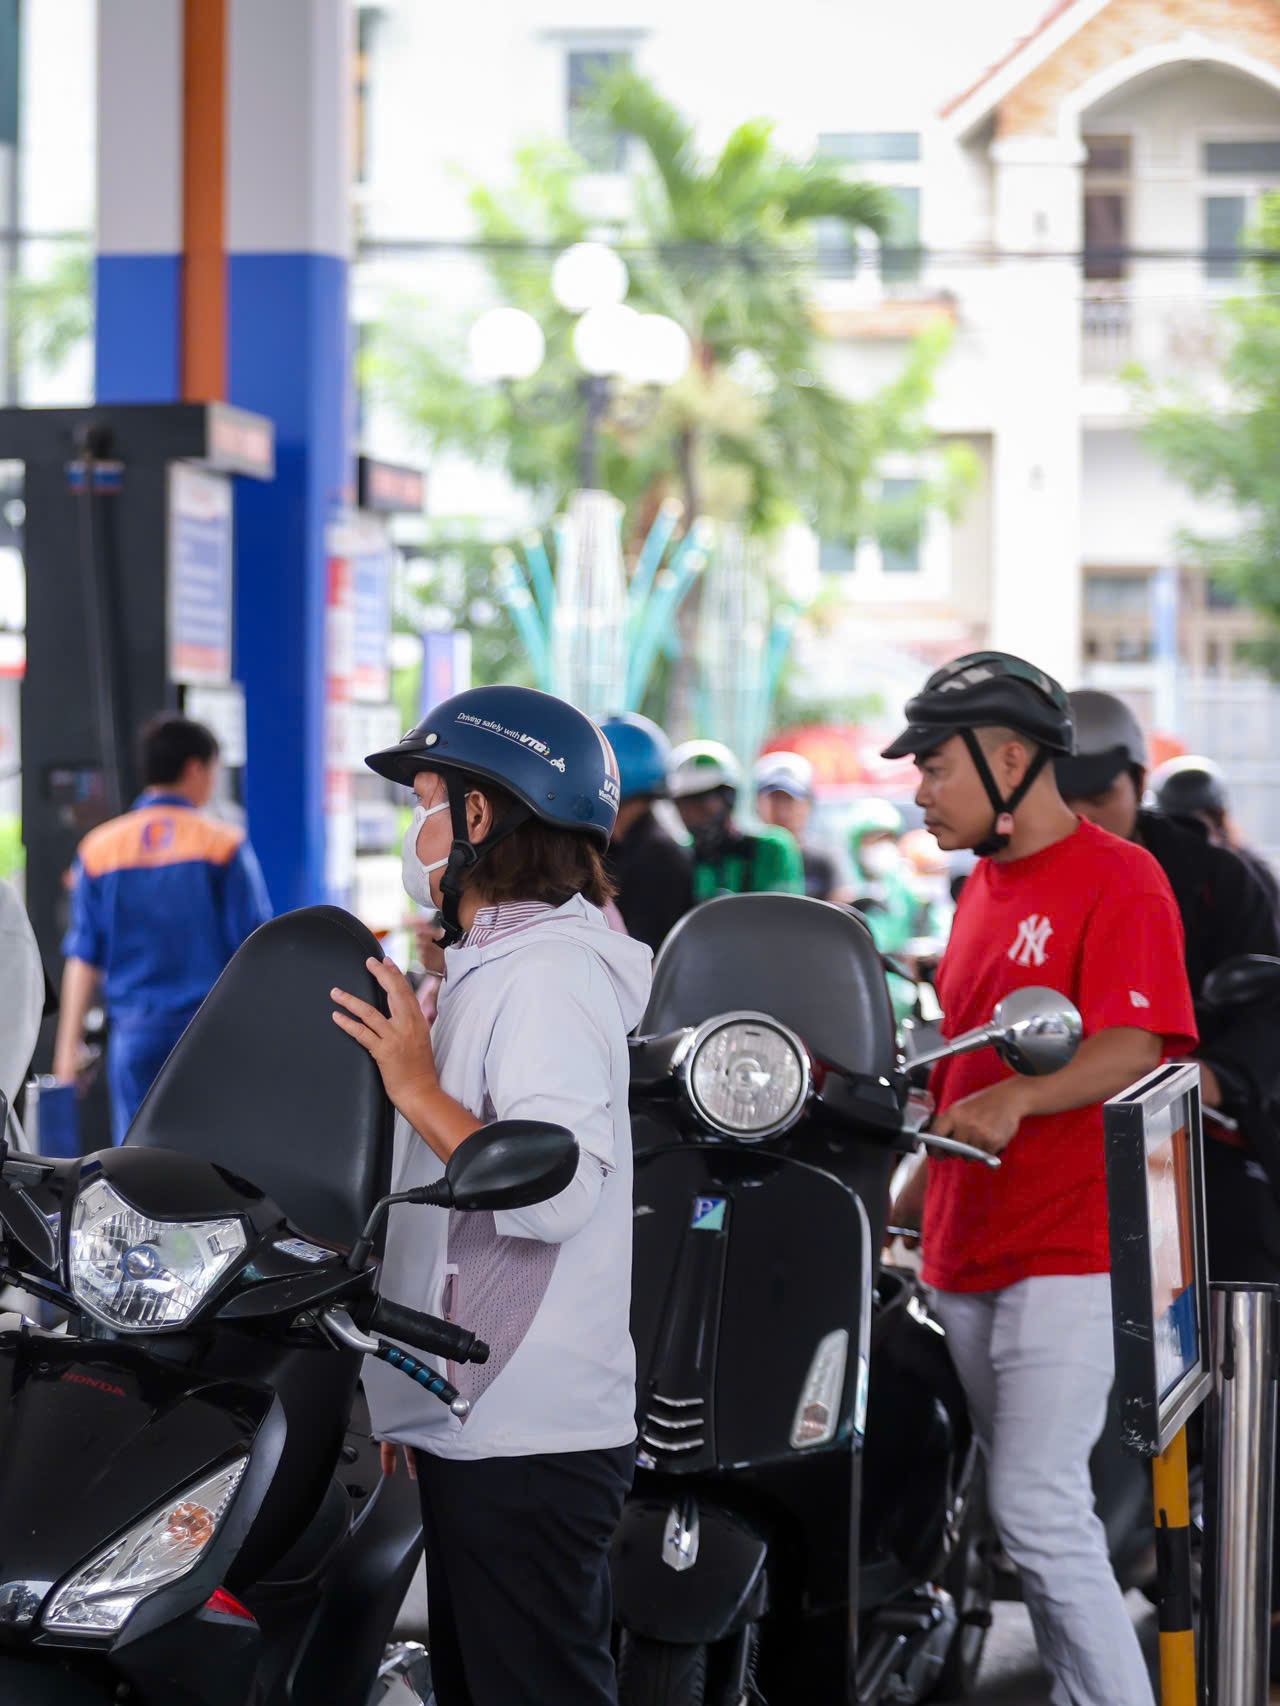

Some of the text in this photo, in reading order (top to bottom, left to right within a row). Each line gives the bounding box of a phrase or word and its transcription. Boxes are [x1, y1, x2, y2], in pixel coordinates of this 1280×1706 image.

[457, 712, 482, 725] Driving
[482, 720, 503, 733] safely
[503, 727, 520, 740] with
[60, 1372, 128, 1398] HONDA
